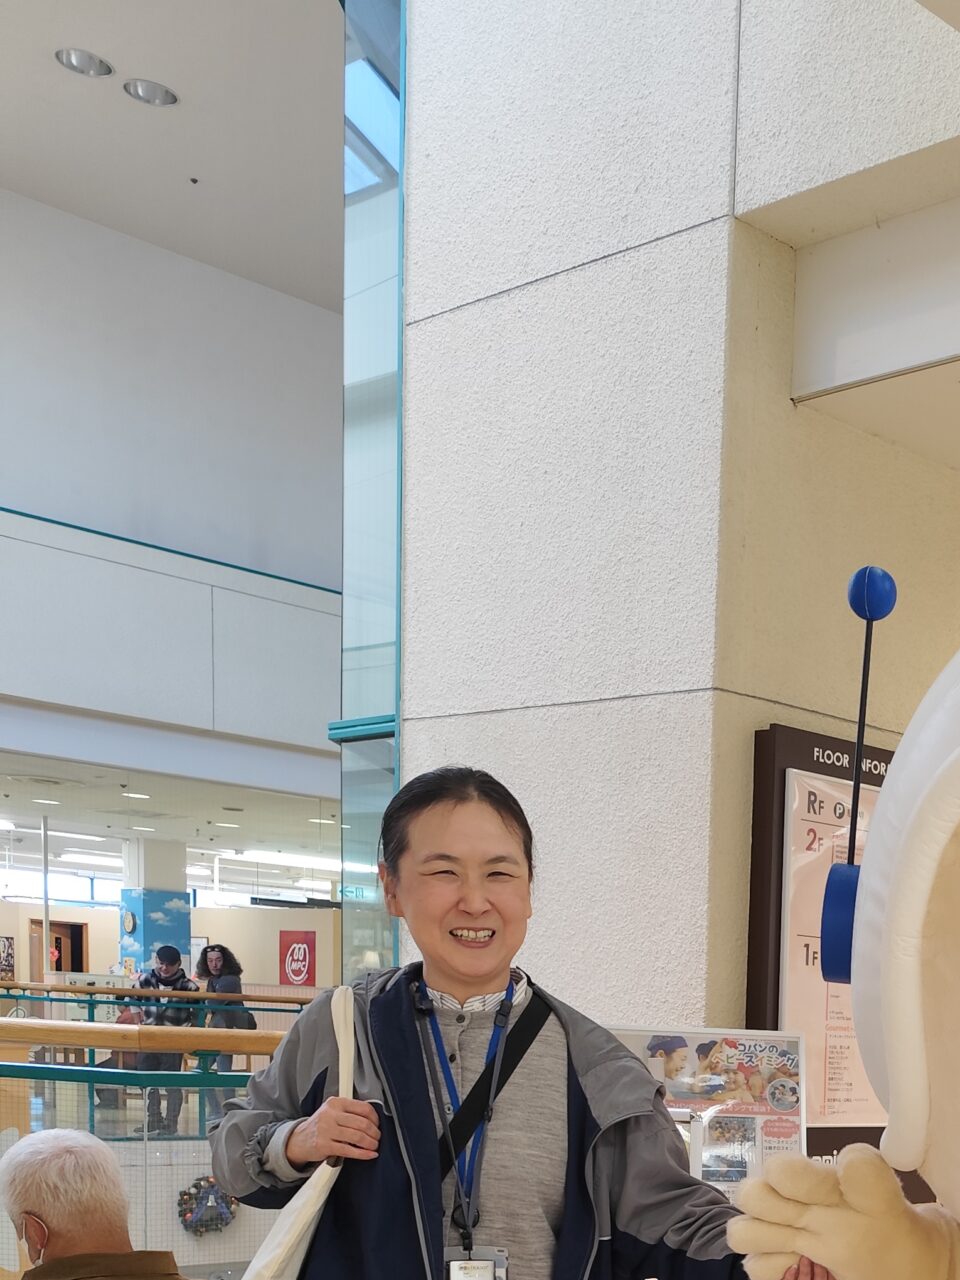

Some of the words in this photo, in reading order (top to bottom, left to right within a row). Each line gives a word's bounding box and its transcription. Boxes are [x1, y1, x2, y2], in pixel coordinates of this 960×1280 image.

[813, 747, 850, 768] FLOOR
[805, 827, 824, 852] 2F
[803, 943, 819, 966] 1F
[291, 961, 306, 970] MPC
[737, 1043, 778, 1053] コバンの
